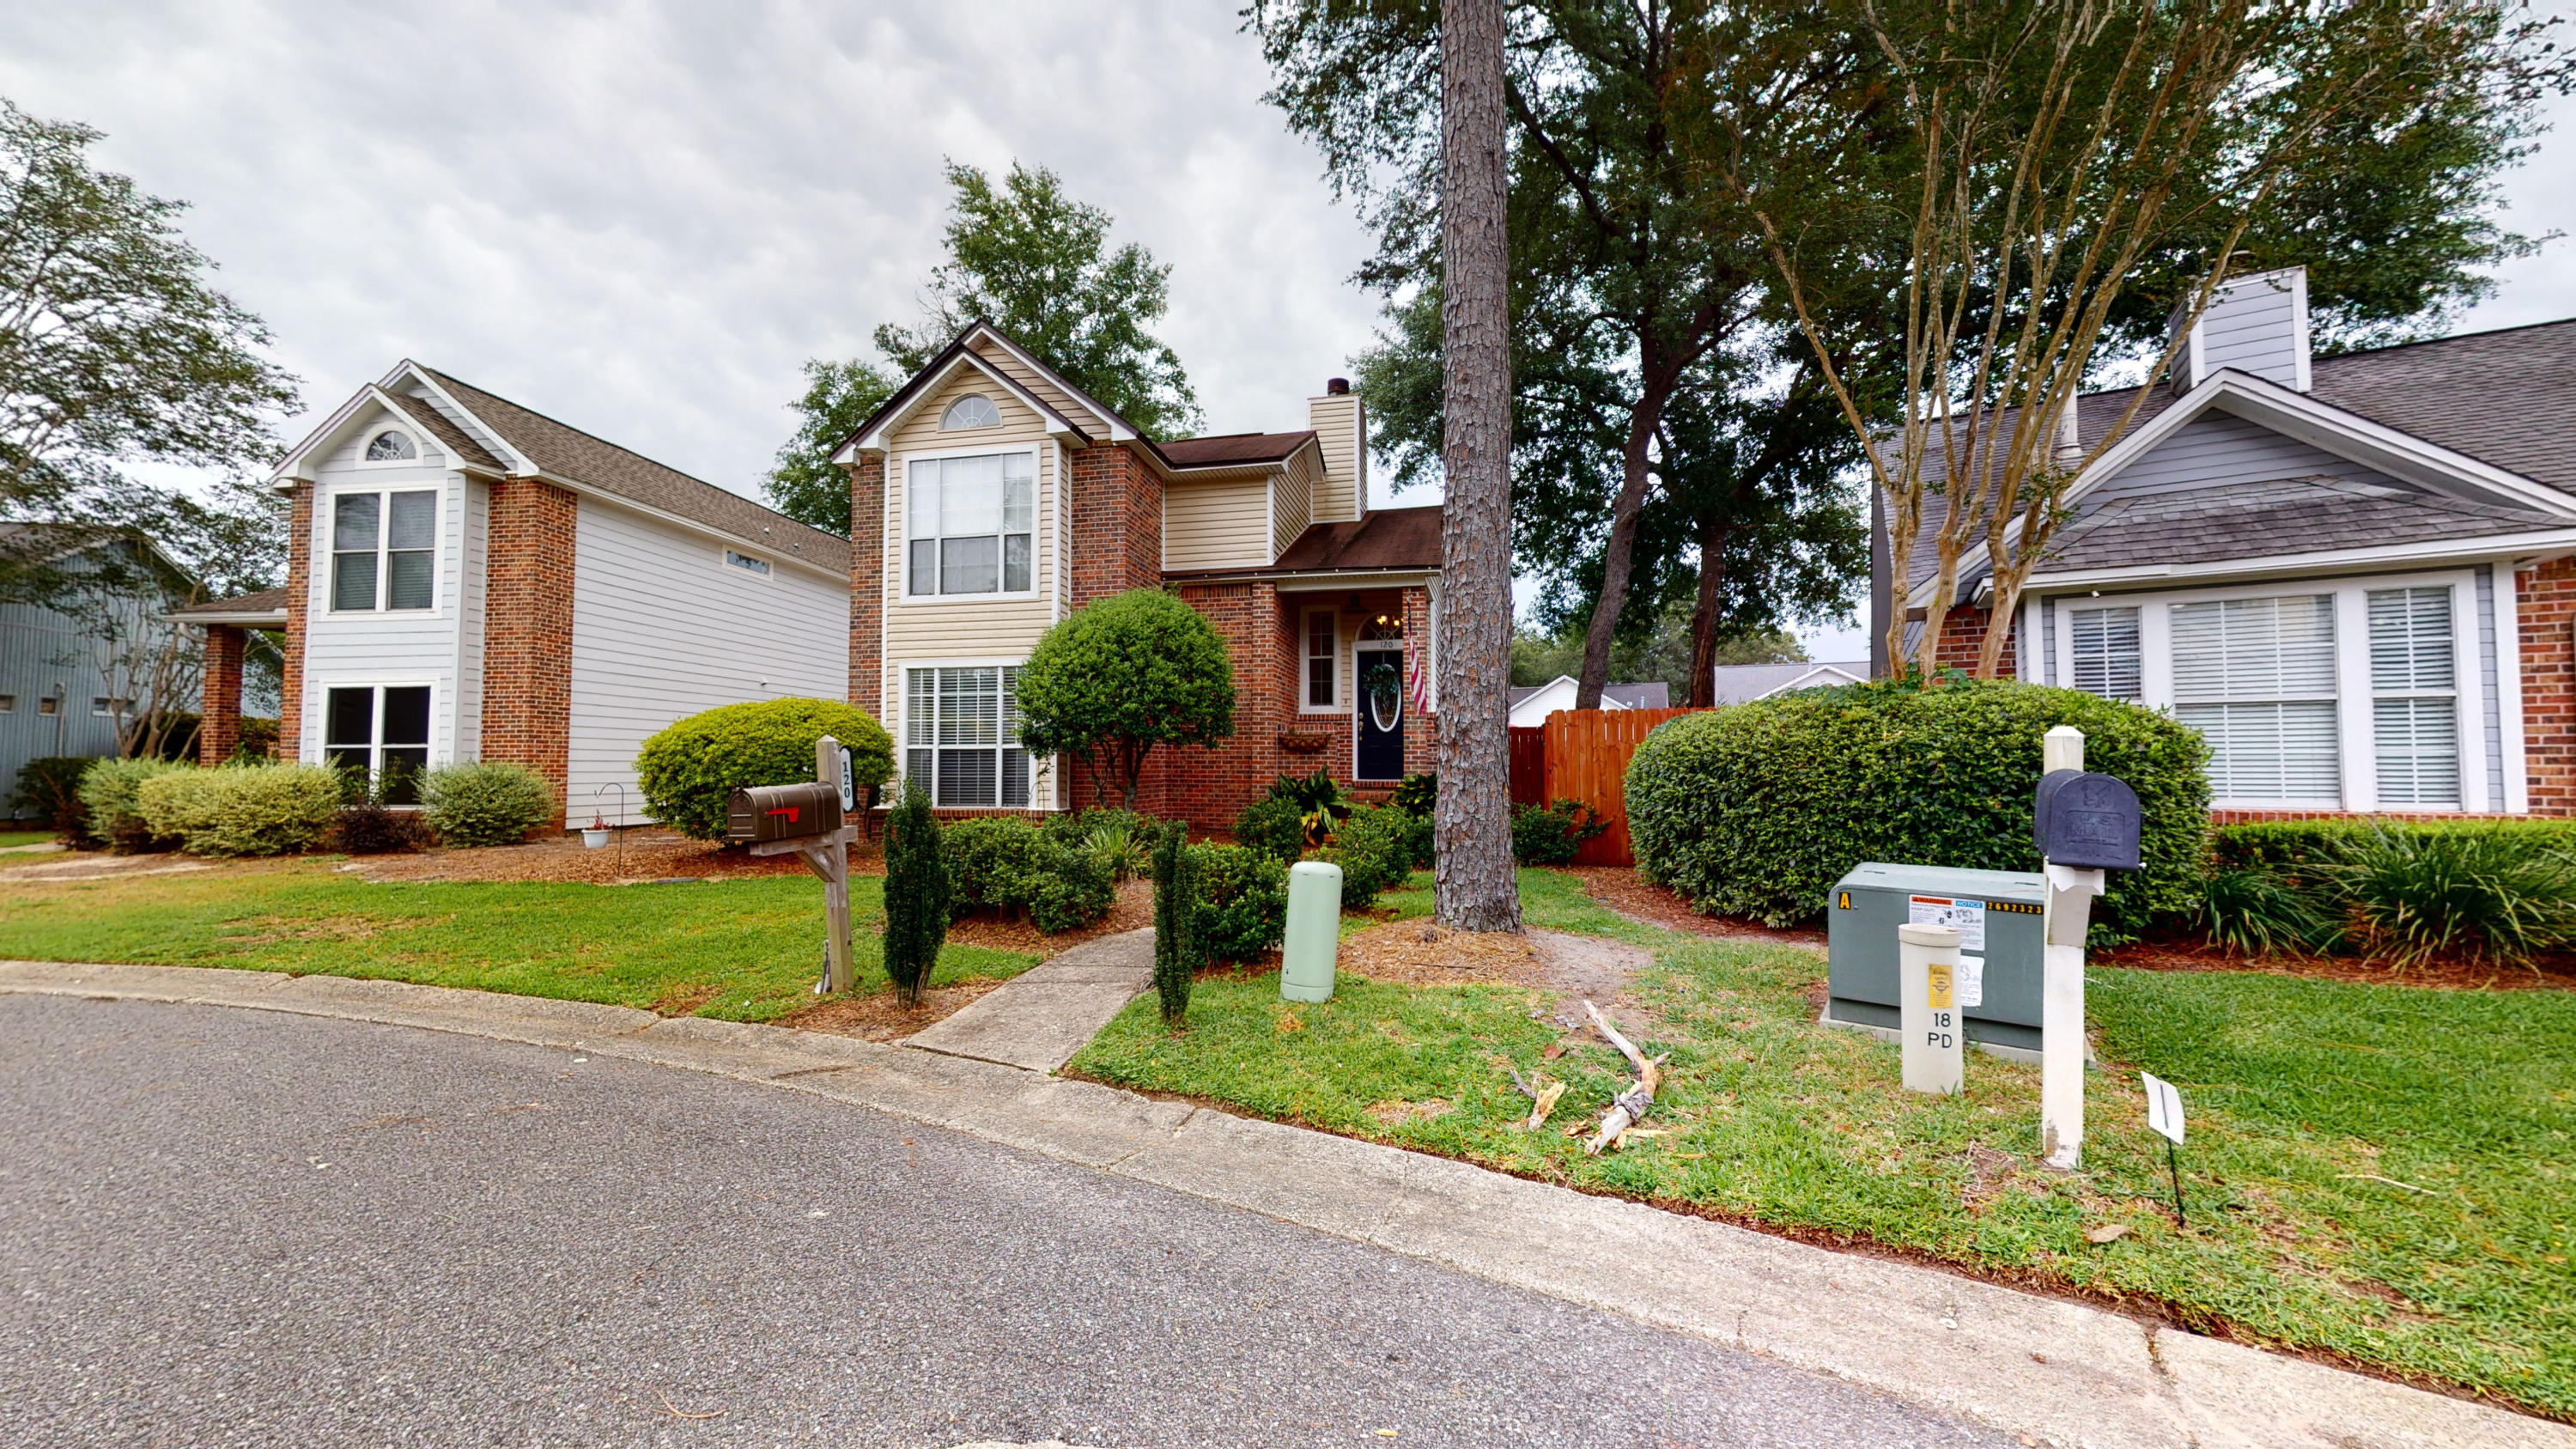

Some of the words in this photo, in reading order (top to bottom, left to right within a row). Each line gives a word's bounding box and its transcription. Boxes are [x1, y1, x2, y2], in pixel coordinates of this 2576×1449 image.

[1840, 892, 1850, 909] A
[1988, 901, 2042, 914] 2692323
[1934, 1013, 1951, 1027] 18
[1928, 1032, 1952, 1048] PD
